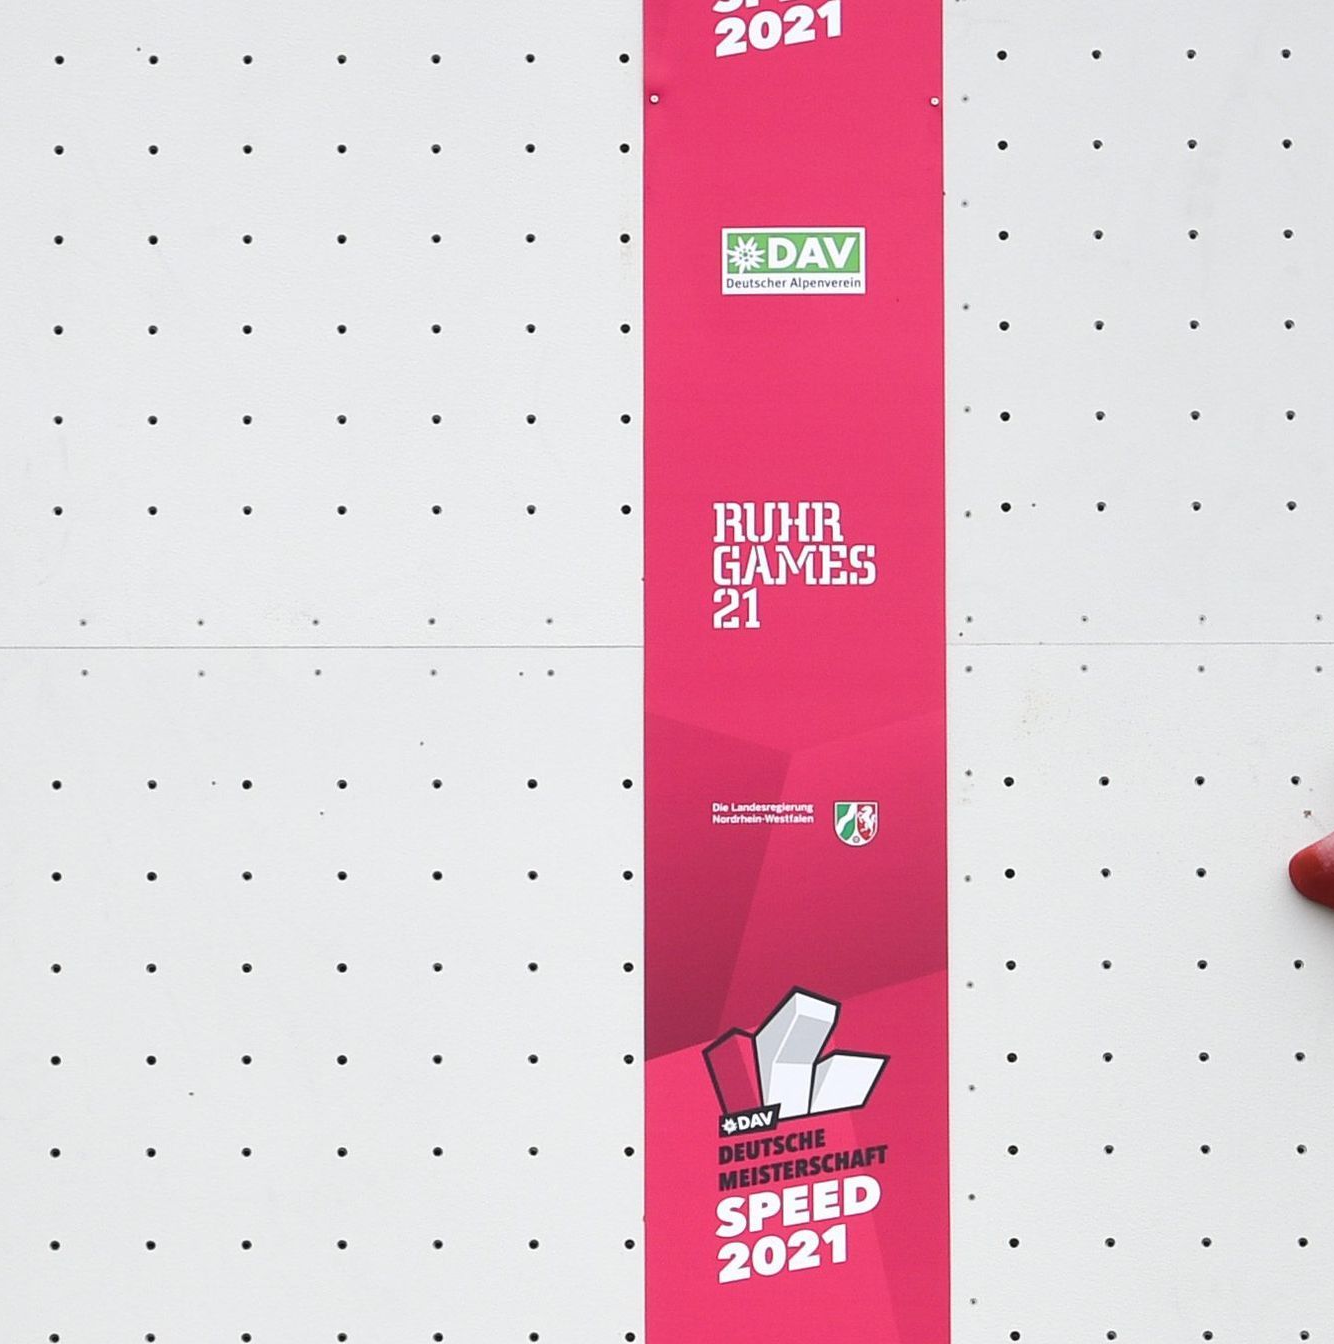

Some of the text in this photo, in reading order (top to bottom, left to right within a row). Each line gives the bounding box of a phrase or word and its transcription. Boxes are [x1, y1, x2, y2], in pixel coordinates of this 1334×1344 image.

[714, 0, 841, 58] 2021
[767, 236, 857, 269] DAV
[726, 277, 861, 290] Deutscher Alpenverein
[713, 501, 844, 542] RUHR
[713, 544, 877, 586] GAMES
[713, 587, 761, 629] 21
[712, 802, 814, 814] Die Landesregierung
[712, 814, 815, 824] Nordrhein-Westfalen
[737, 1110, 773, 1131] DAV
[719, 1128, 826, 1165] DEUTSCHE
[719, 1144, 888, 1191] MEISTERSCHAFT
[715, 1174, 882, 1238] SPEED
[717, 1223, 847, 1284] 2021
